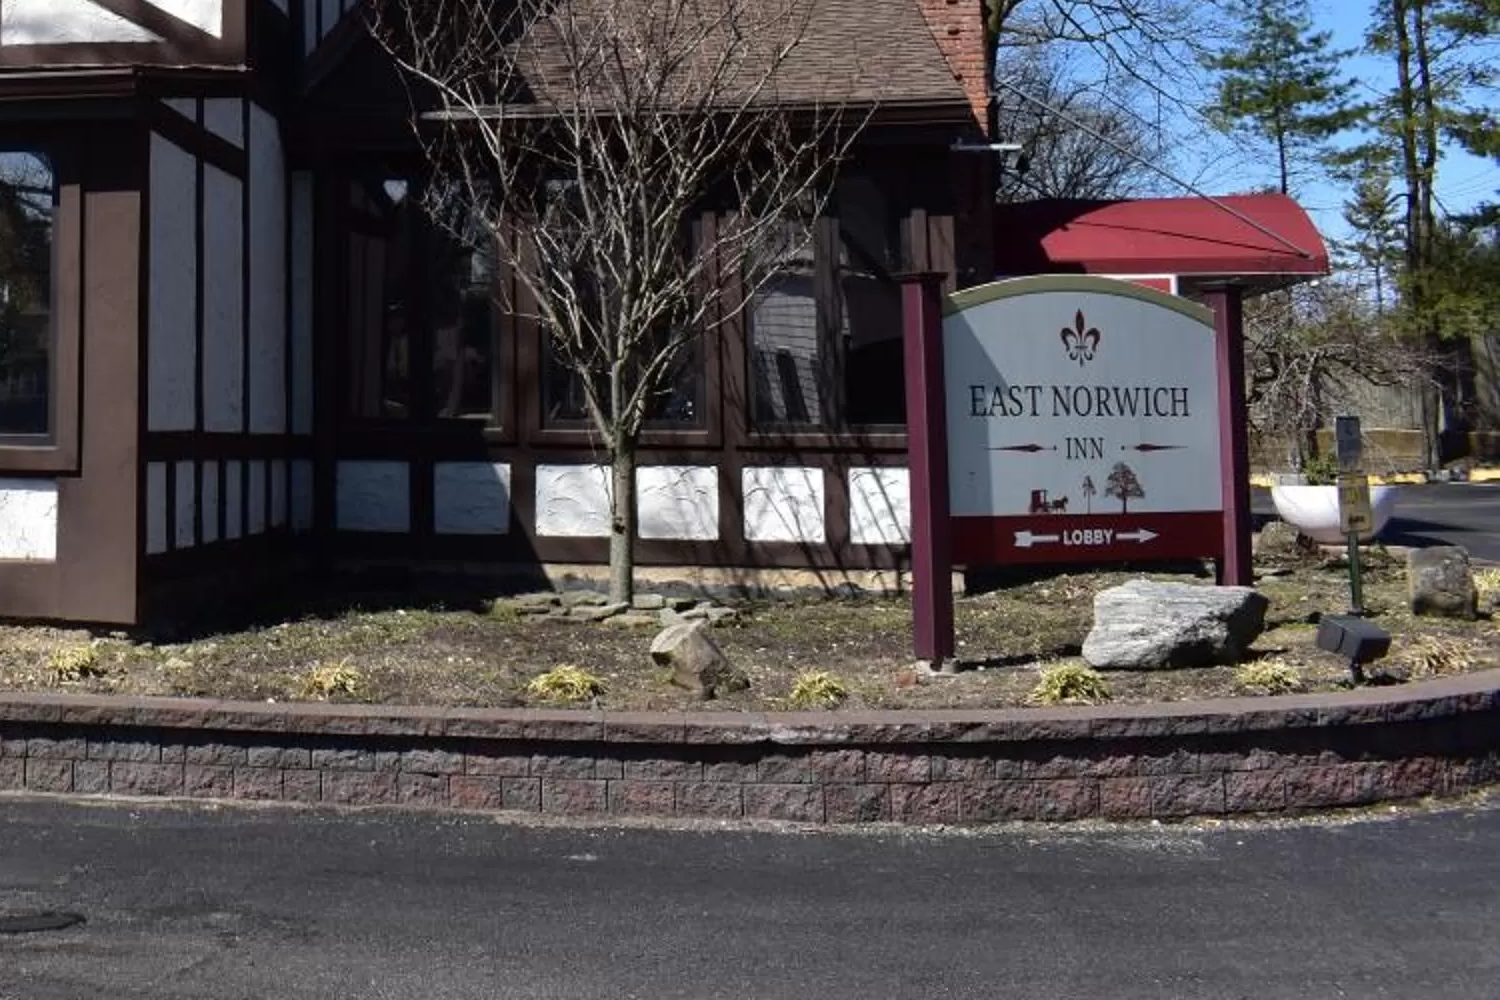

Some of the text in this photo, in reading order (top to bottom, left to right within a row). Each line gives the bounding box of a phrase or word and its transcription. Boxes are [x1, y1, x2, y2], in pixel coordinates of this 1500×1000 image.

[968, 385, 1191, 418] EAST NORWICH
[1065, 437, 1105, 460] INN
[1063, 529, 1113, 546] LOBBY
